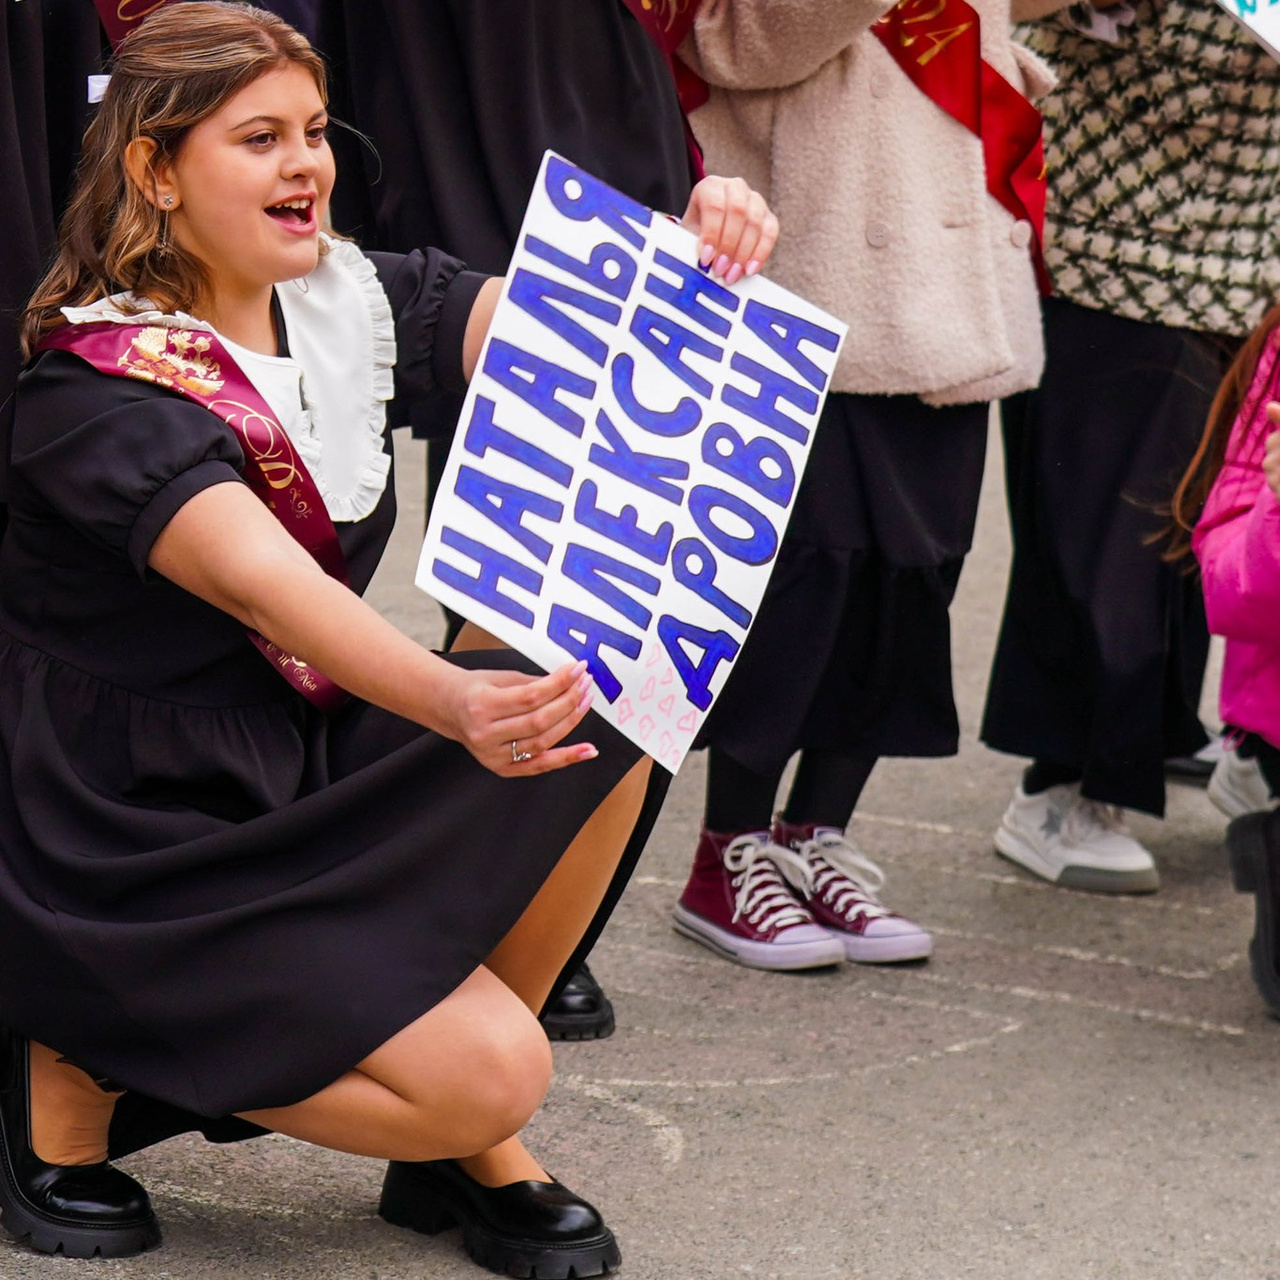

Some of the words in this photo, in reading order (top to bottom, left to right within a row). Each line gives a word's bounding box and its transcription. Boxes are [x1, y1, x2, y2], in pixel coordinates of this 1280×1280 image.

[431, 155, 655, 628] НАТАЛЬЯ
[546, 246, 741, 705] АЛЕКСАН
[656, 297, 841, 712] ДРОВНА
